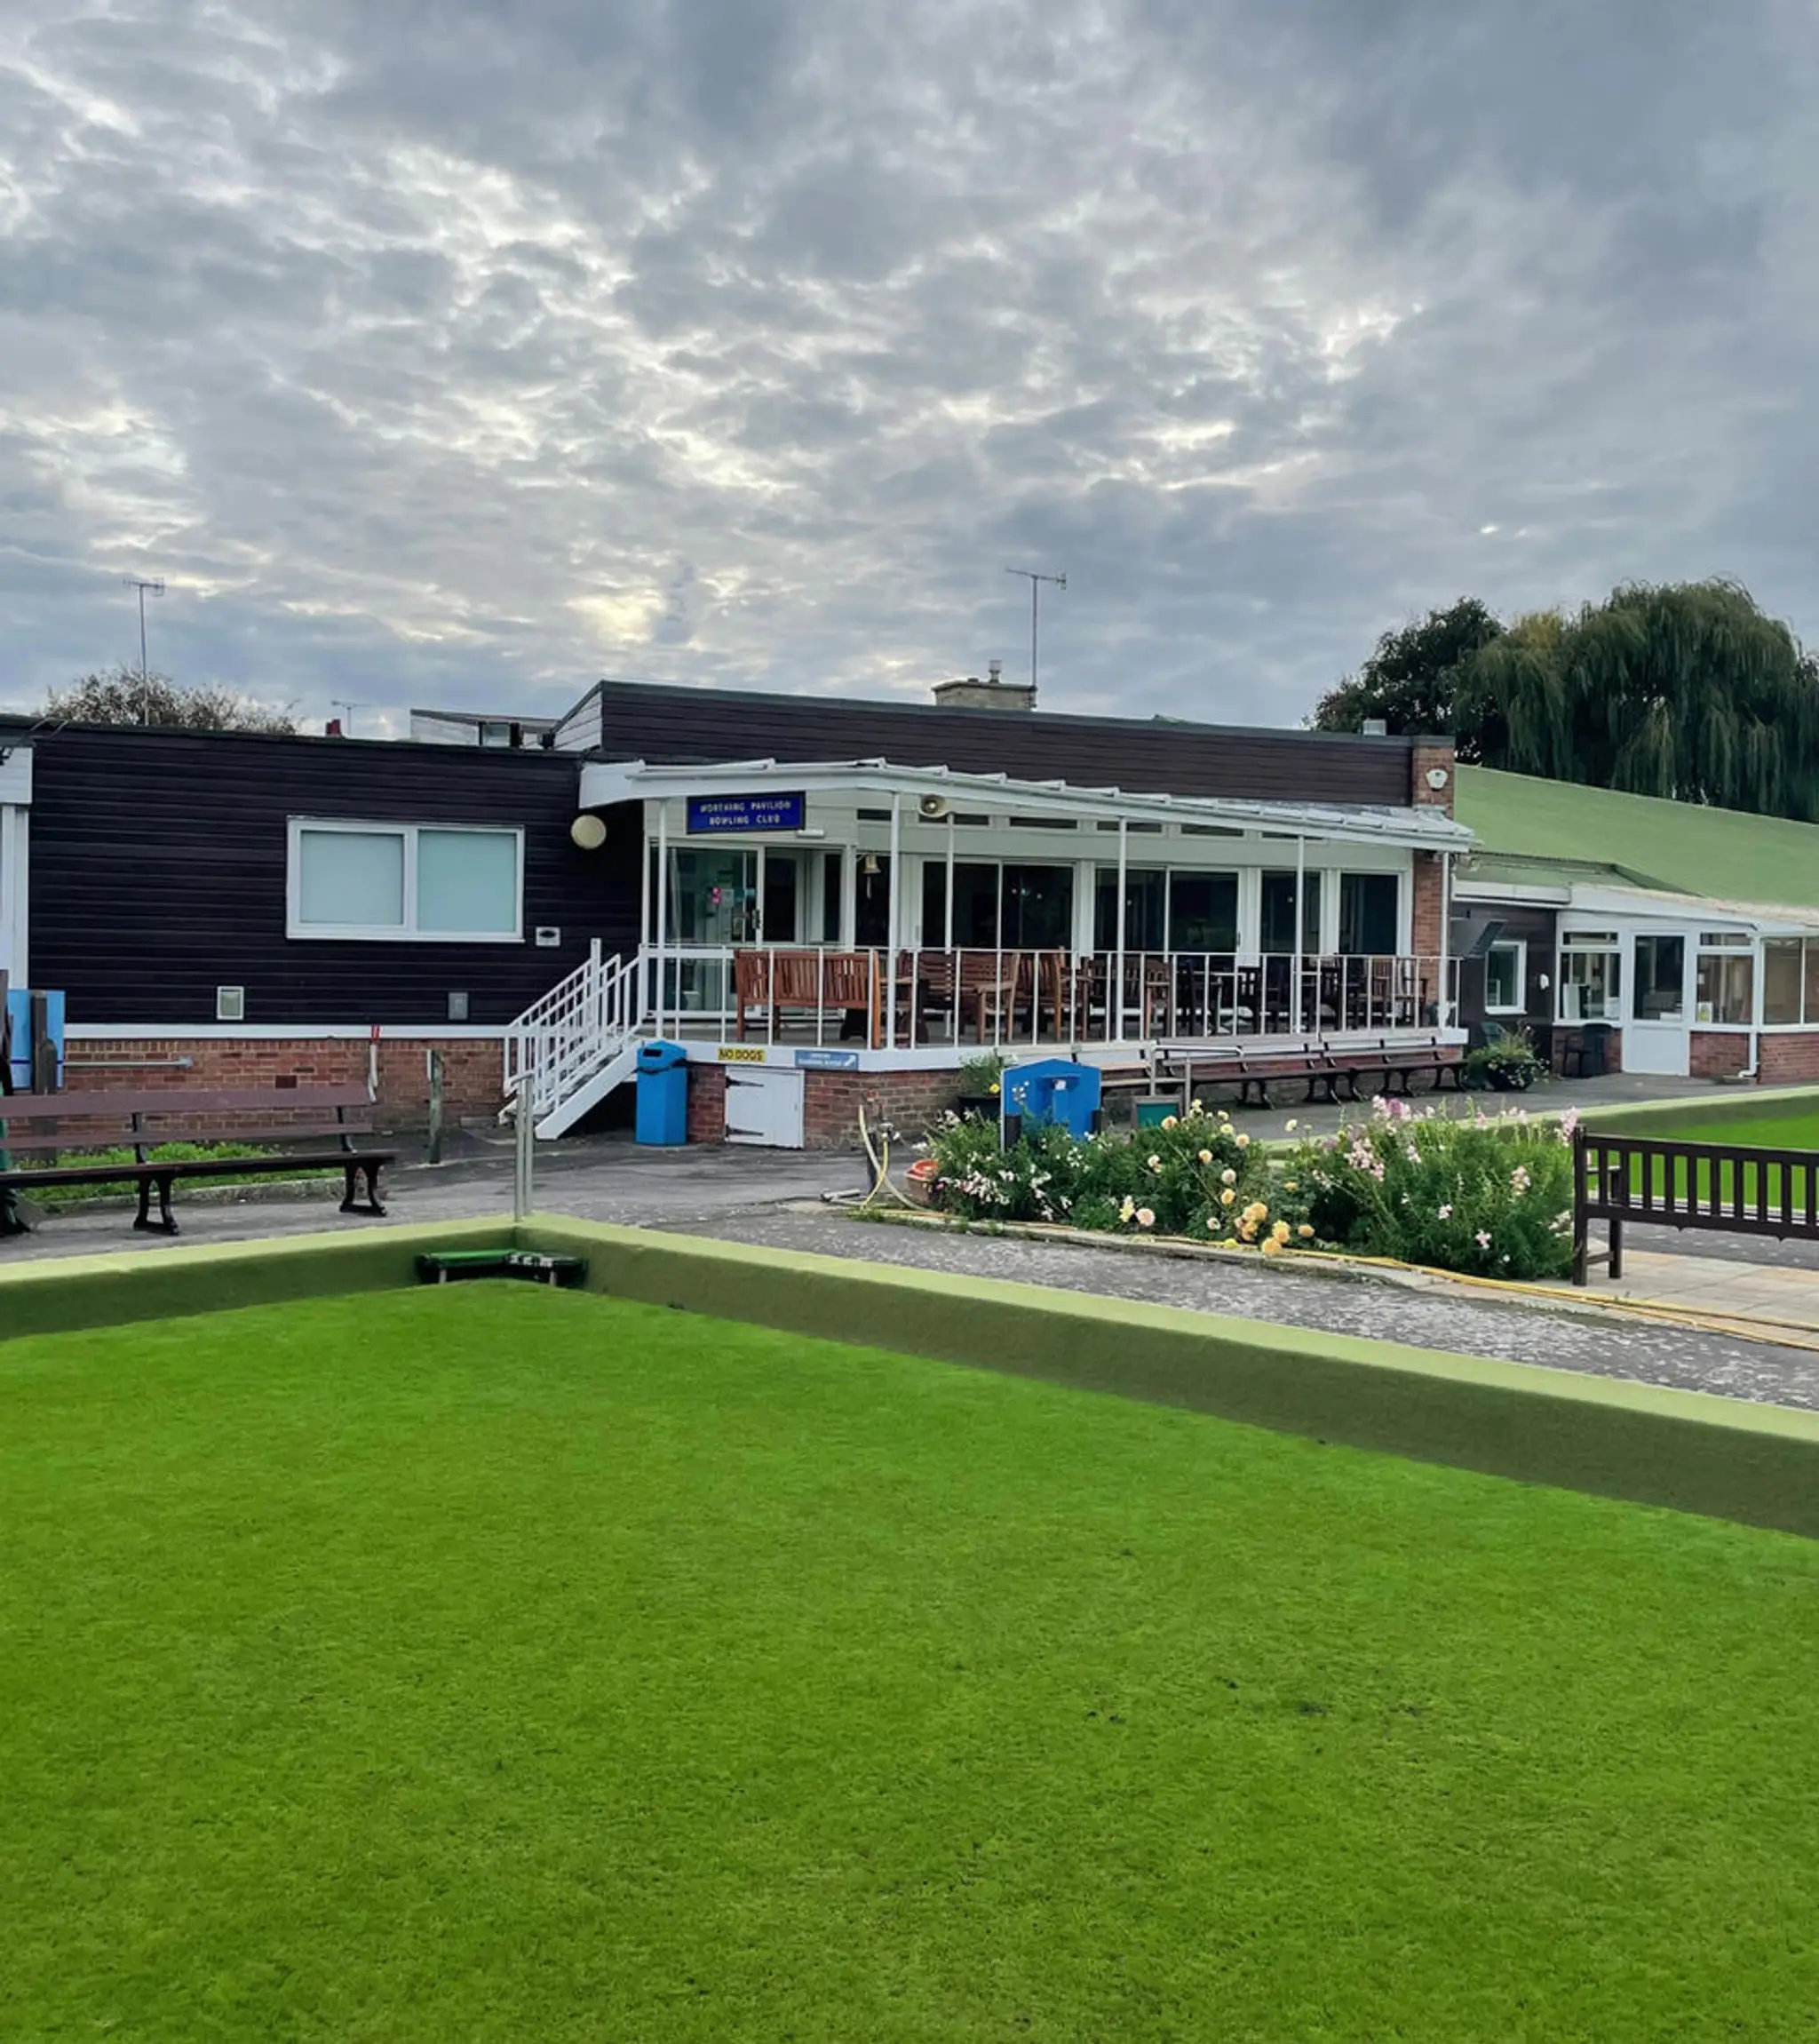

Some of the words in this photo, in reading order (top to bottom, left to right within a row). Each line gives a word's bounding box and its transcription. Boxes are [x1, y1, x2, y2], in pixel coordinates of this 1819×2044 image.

[751, 800, 791, 810] PAVILION
[709, 815, 749, 825] BOWLING
[756, 814, 780, 823] CLUB
[719, 1048, 733, 1060] NO
[735, 1049, 762, 1061] DOGS
